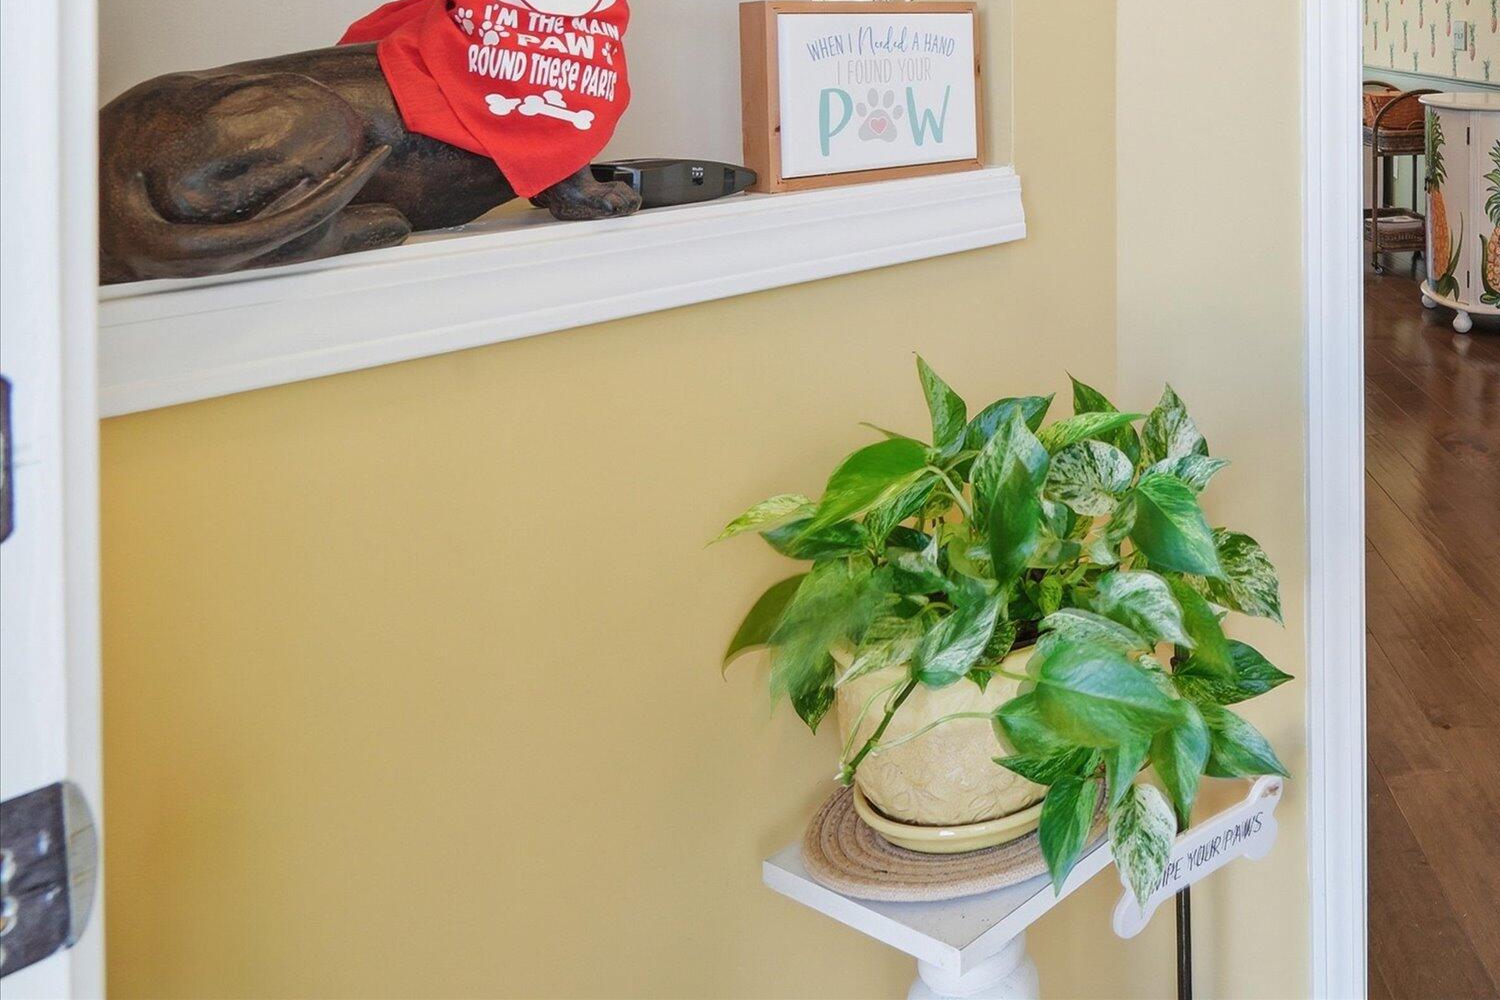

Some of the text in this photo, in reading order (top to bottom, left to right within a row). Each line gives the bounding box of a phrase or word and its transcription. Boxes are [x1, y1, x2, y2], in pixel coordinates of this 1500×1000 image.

[484, 4, 518, 29] I'M
[571, 19, 619, 41] MAIN
[517, 32, 594, 60] PAW
[807, 35, 844, 61] WHEN
[858, 26, 907, 56] Needed
[911, 32, 920, 50] A
[923, 32, 956, 57] HAND
[468, 44, 527, 82] ROUND
[580, 65, 618, 102] PARTS
[847, 58, 893, 85] FOUND
[897, 56, 932, 82] YOUR
[1187, 836, 1222, 870] YOUR
[1223, 812, 1263, 851] PAWS
